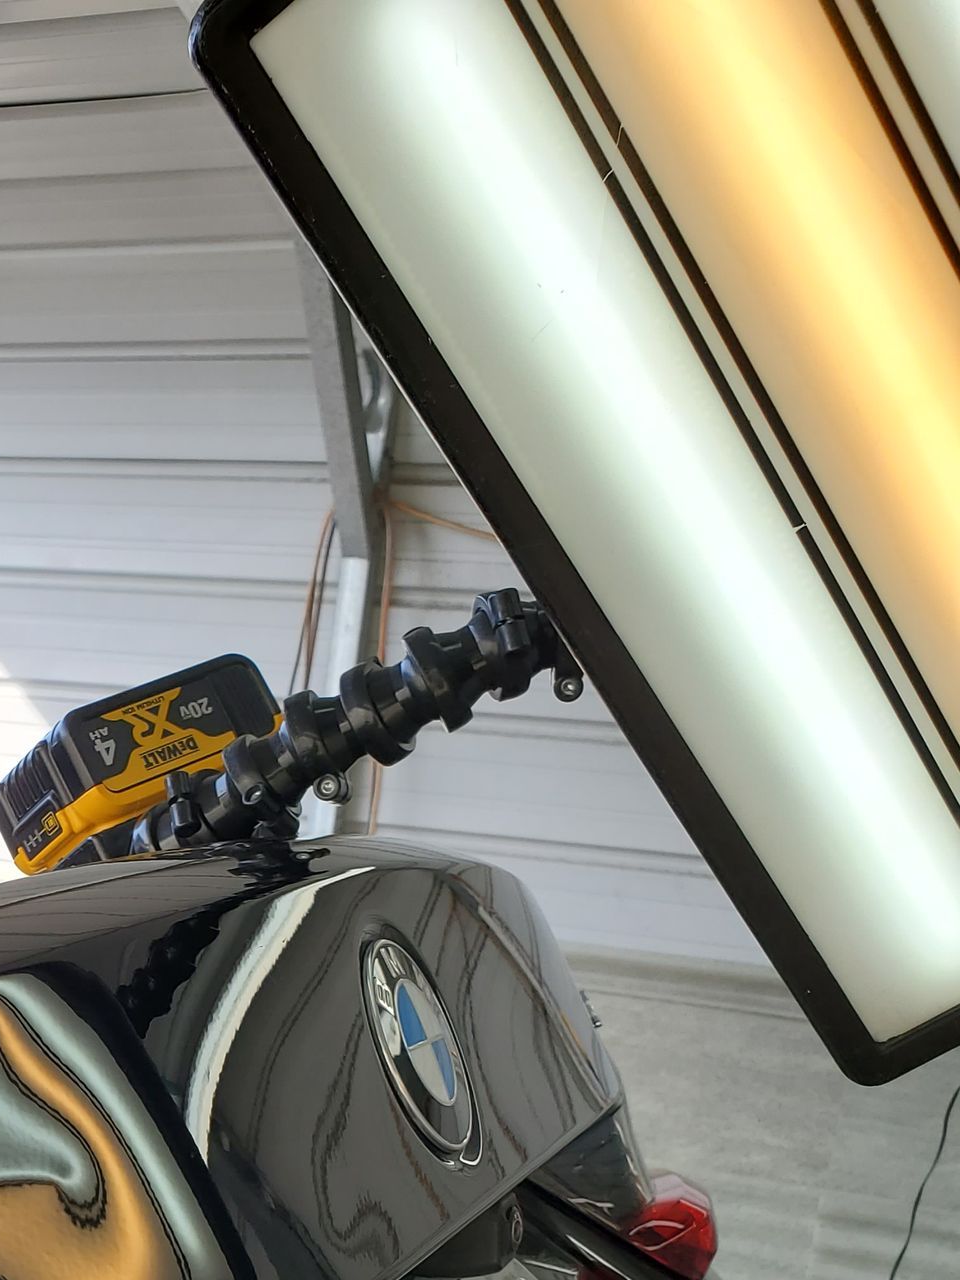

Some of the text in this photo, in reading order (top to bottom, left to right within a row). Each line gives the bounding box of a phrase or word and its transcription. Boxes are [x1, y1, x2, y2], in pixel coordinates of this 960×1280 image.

[122, 695, 164, 715] LITHIUM ION
[89, 727, 109, 741] AH
[94, 739, 116, 766] 4
